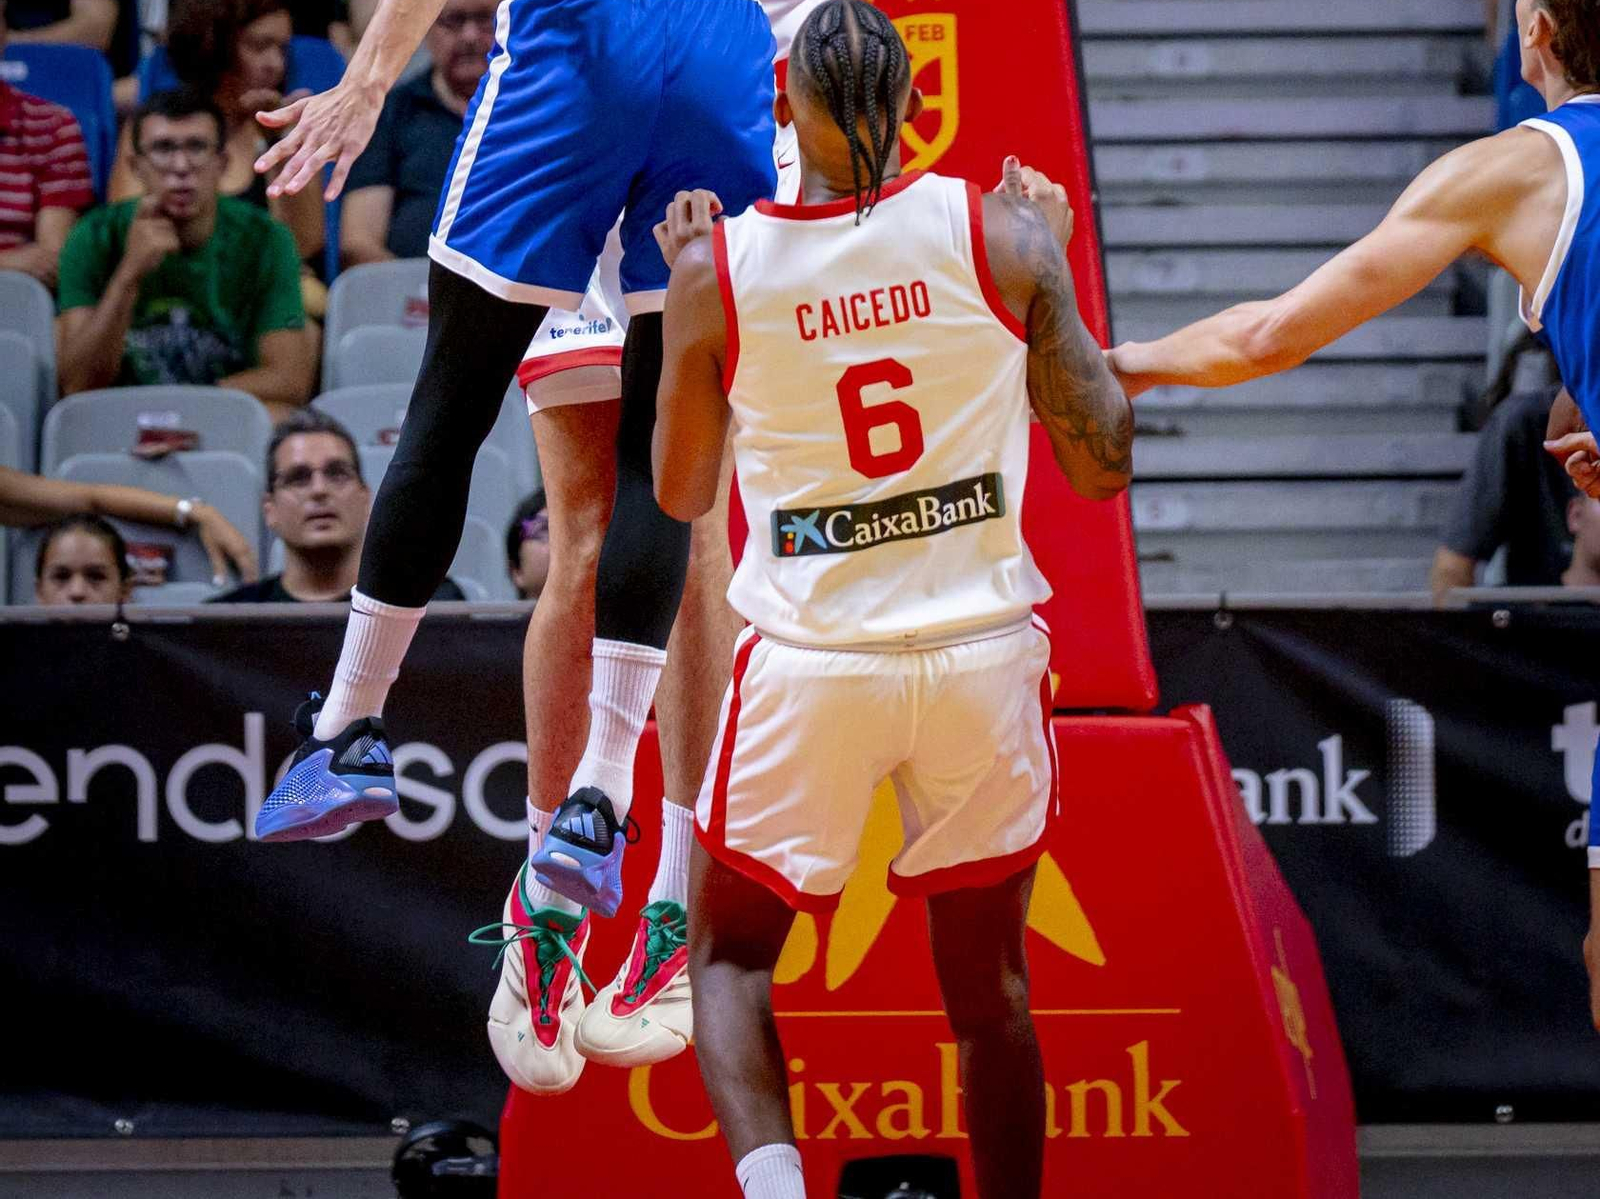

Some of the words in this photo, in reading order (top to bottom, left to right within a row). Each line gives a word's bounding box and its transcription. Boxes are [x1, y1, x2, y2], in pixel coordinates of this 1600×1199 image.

[905, 24, 945, 41] FEB
[795, 280, 931, 341] CAICEDO
[836, 357, 924, 479] 6
[824, 482, 996, 548] CaixaBank
[0, 712, 528, 845] ends
[628, 1039, 1190, 1141] Cixank
